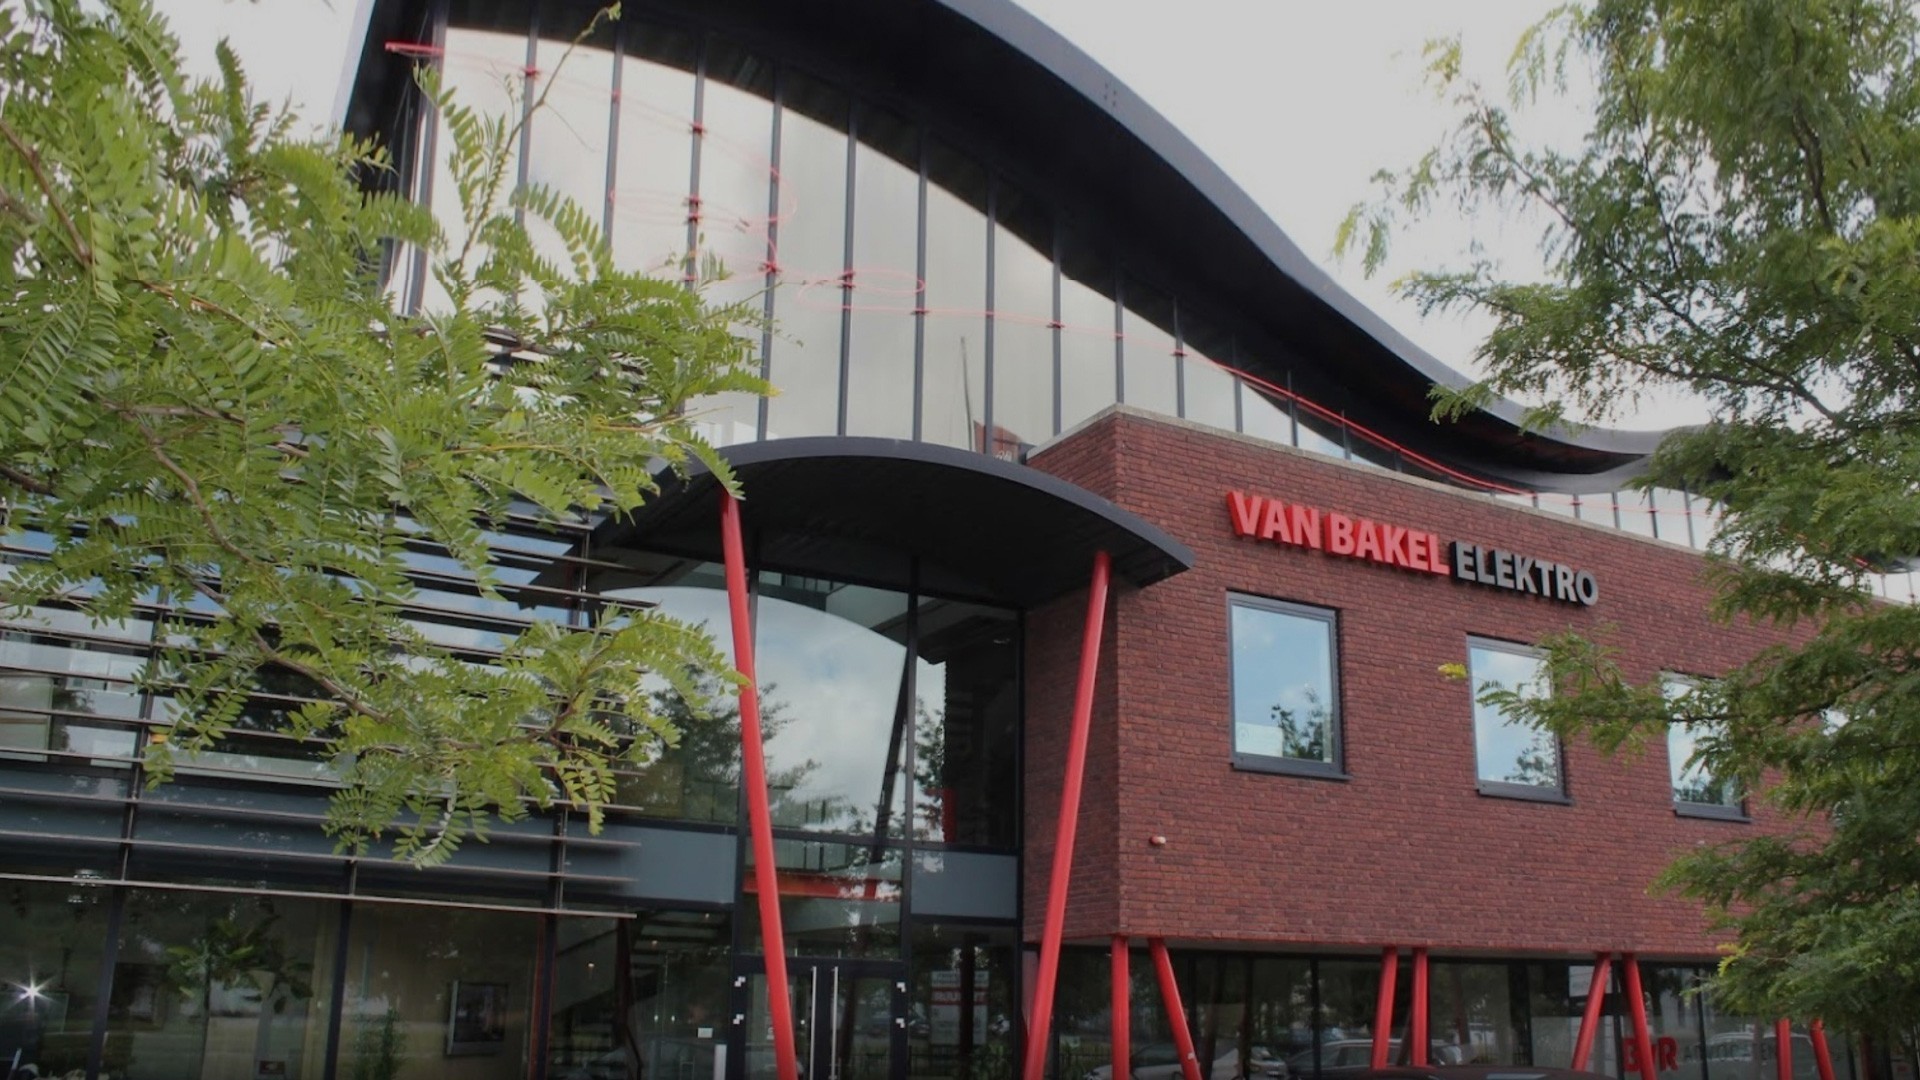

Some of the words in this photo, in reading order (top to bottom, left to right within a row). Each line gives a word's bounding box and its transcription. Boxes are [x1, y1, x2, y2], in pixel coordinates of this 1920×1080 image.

[1228, 491, 1321, 549] VAN
[1325, 512, 1449, 576] BAKEL
[1450, 540, 1599, 606] ELEKTRO
